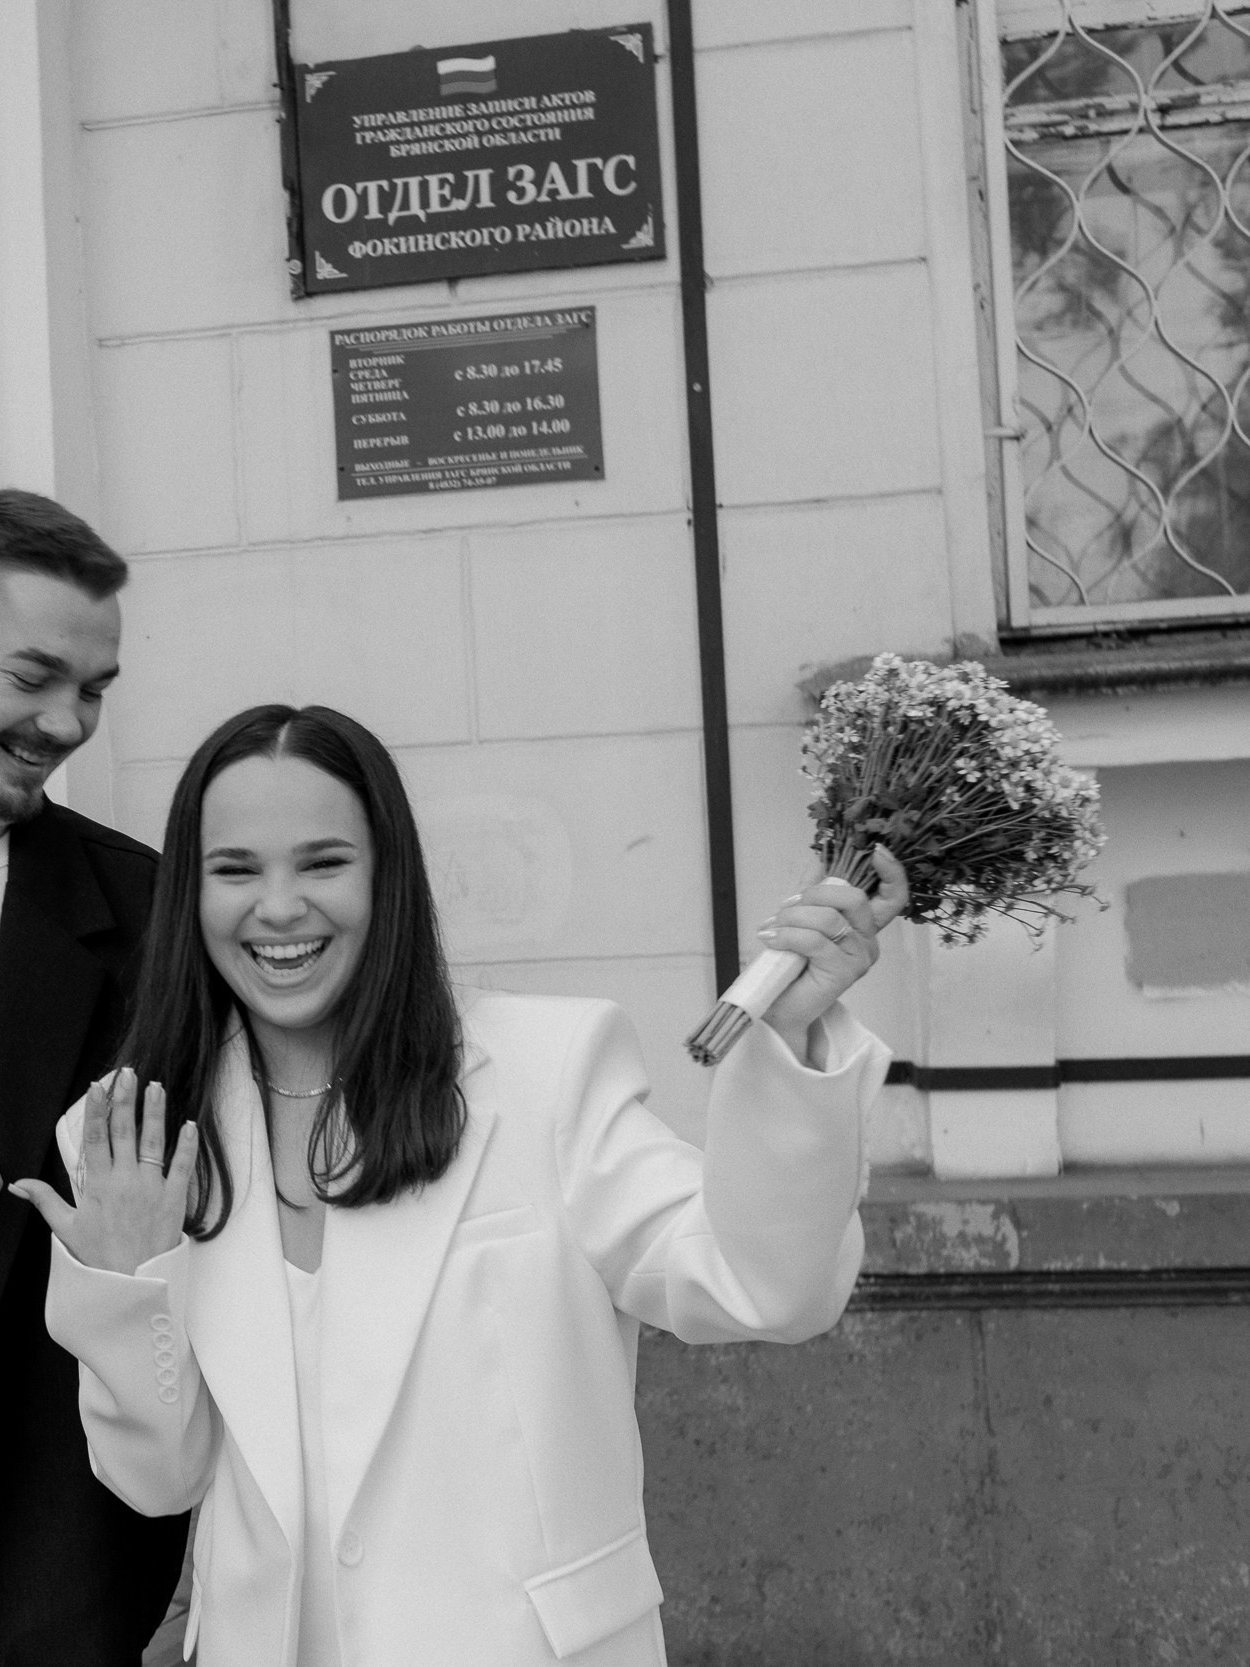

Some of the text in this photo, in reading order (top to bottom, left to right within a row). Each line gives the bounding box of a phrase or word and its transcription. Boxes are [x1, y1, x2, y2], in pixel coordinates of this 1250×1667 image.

[352, 90, 596, 128] УПРАВЛЕНИЕ ЗАПИСИ АКТОВ
[355, 107, 595, 145] ГРАЖДАНСКОГО СОСТОЯНИЯ
[389, 127, 561, 158] БРЯНСКОЙ ОБЛАСТИ
[321, 153, 638, 226] ОТДЕЛ ЗАГС
[348, 215, 617, 259] ФОКИНСКОГО РАЙОНА
[334, 310, 592, 346] РАСПОРЯДОК РАБОТЫ ОТДЕЛА ЗАГС
[349, 355, 405, 369] ВТОРНИК
[454, 357, 563, 381] с 8.30 до 17.45
[349, 369, 389, 381] СРЕДА
[350, 379, 402, 392] ЧЕТВЕРГ
[351, 390, 410, 404] ПЯТНИЦА
[456, 394, 565, 417] с 8.30 до 16.30
[352, 412, 407, 425] СУББОТА
[453, 418, 571, 442] с 13.00 до 14.00
[353, 435, 410, 449] ПЕРЕРЫВ
